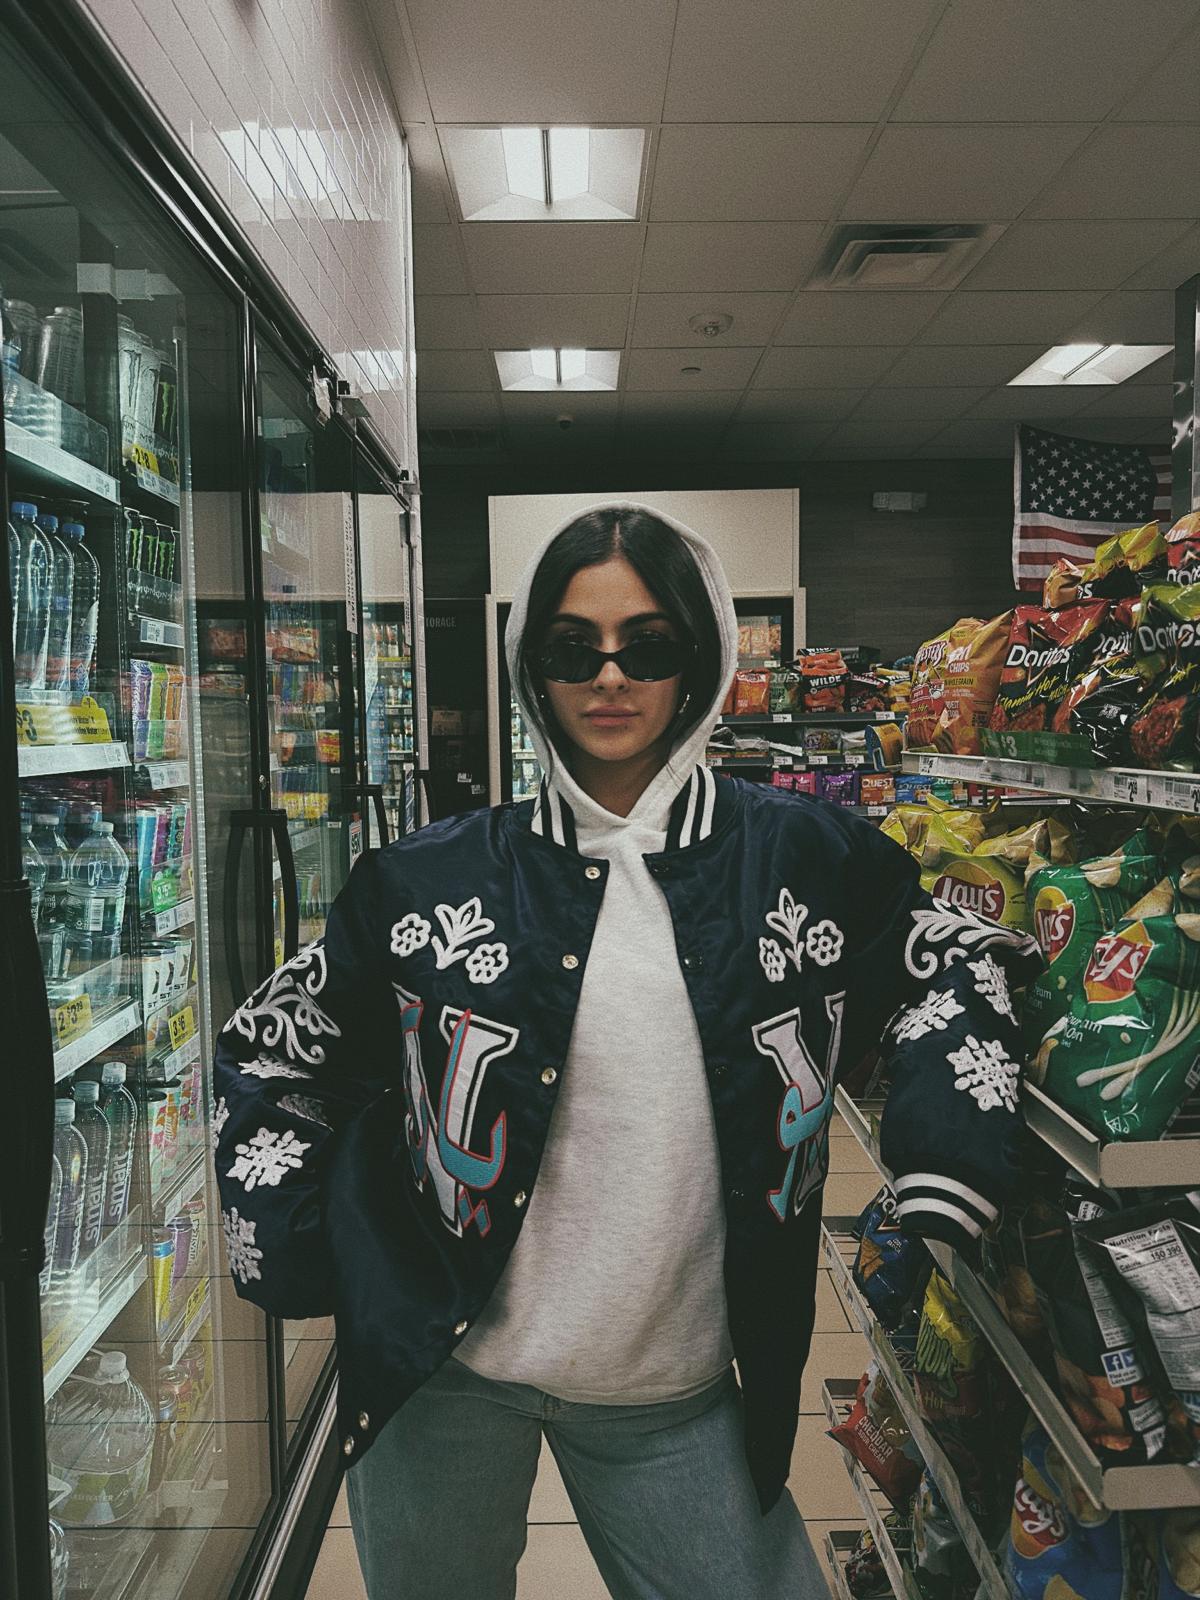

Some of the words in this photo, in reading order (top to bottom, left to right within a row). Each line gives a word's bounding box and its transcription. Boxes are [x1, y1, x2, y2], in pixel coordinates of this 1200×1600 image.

[425, 616, 457, 629] TORAGE
[1006, 642, 1072, 668] Doritos
[770, 672, 800, 684] QUES
[810, 675, 843, 688] WILDE
[1035, 675, 1061, 696] Hot
[861, 776, 895, 788] QUEST
[109, 1151, 128, 1220] smart
[85, 1171, 104, 1243] smart
[1108, 1232, 1147, 1249] Nutrition
[858, 1415, 894, 1458] CHEDDAR
[867, 1443, 886, 1465] CREAM
